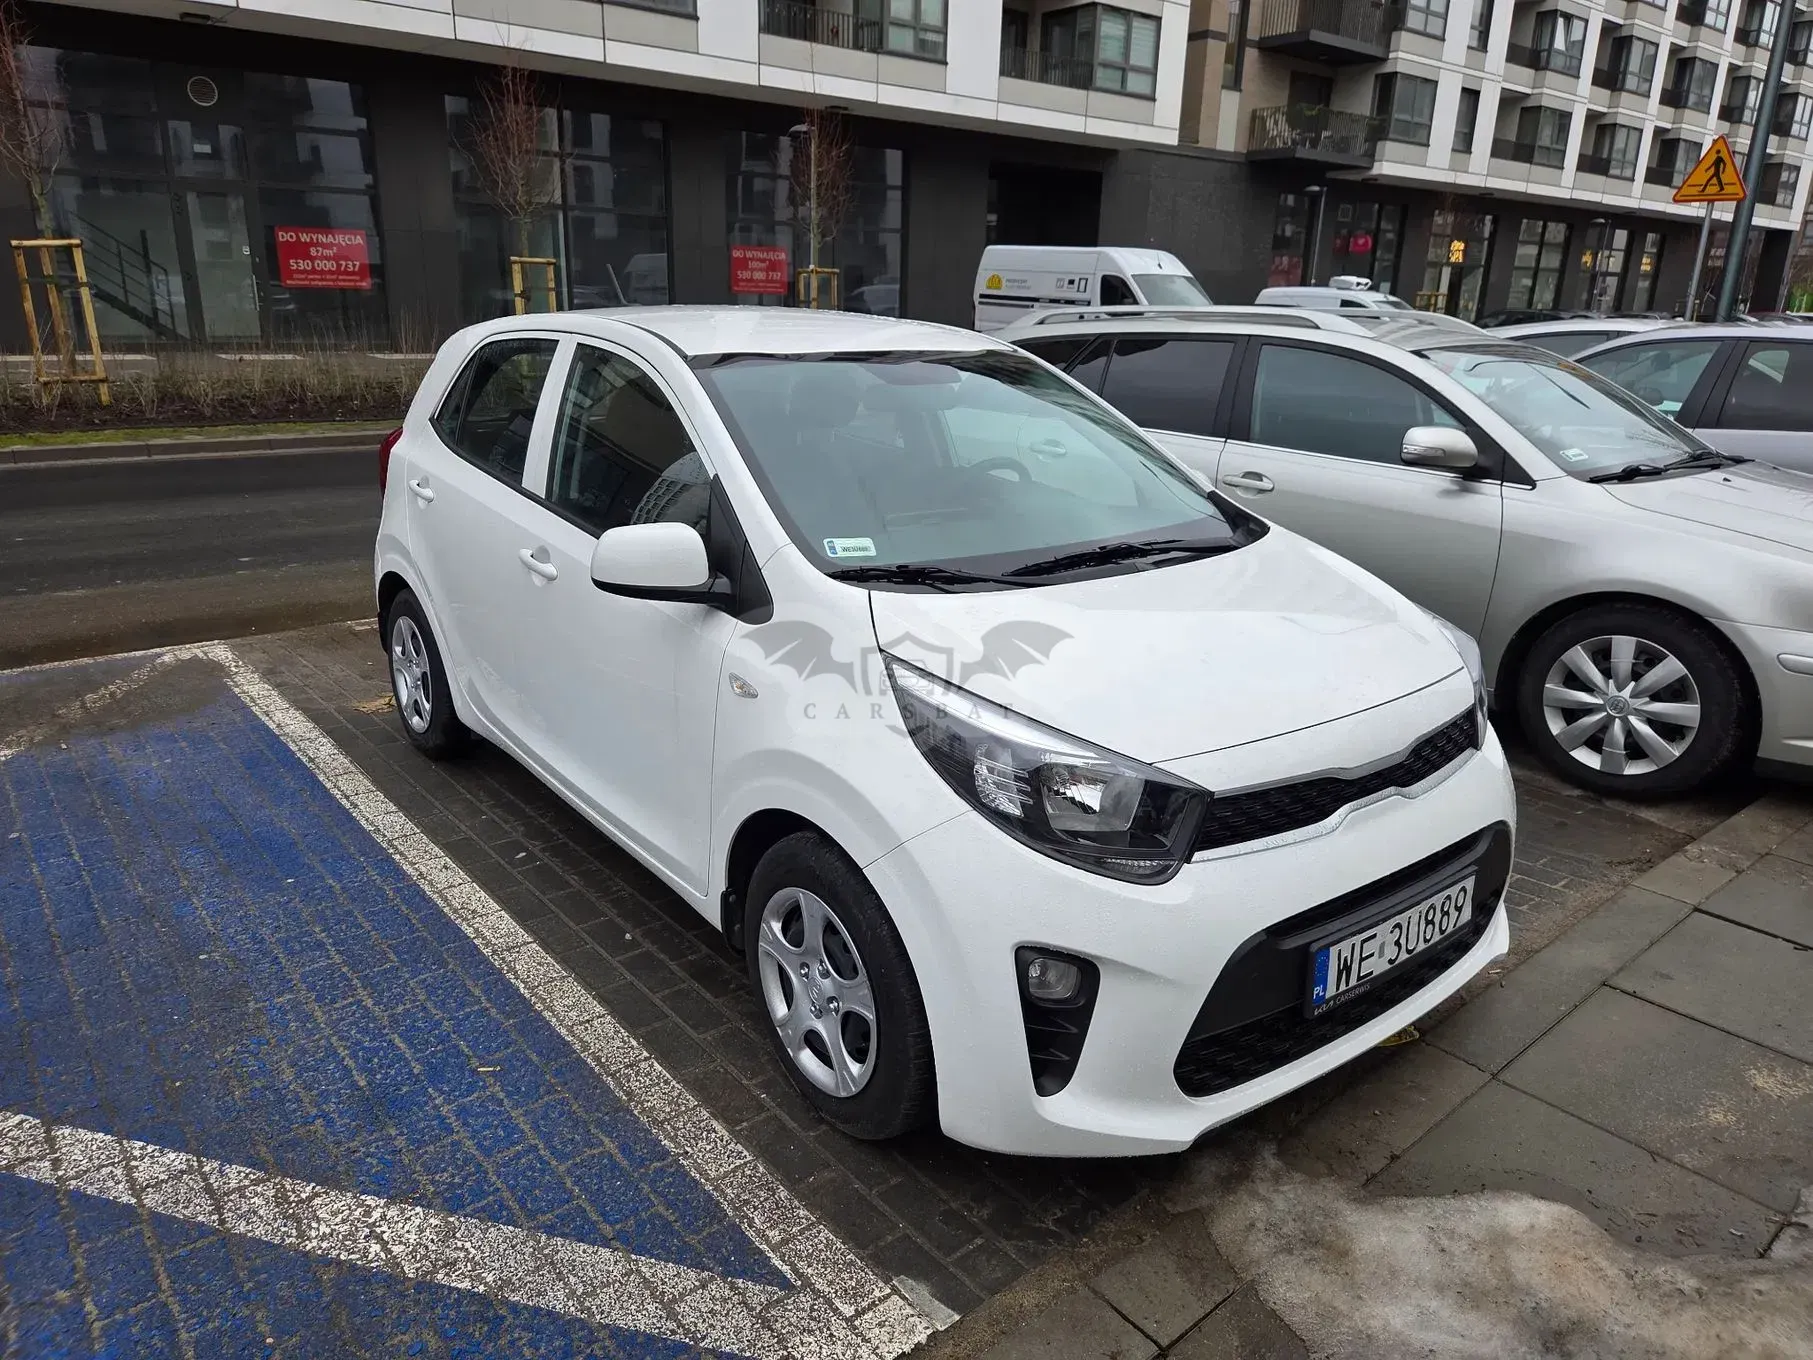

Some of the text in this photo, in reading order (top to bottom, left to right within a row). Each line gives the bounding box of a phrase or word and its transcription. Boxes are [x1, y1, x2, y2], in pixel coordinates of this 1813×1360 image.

[278, 231, 364, 247] DO WYNAJĘCIA
[732, 249, 744, 258] DO
[289, 259, 360, 272] 530 000 737
[1335, 885, 1468, 993] WE 3U889
[1312, 985, 1325, 1000] PL
[1336, 983, 1370, 1004] CARSERWIS
